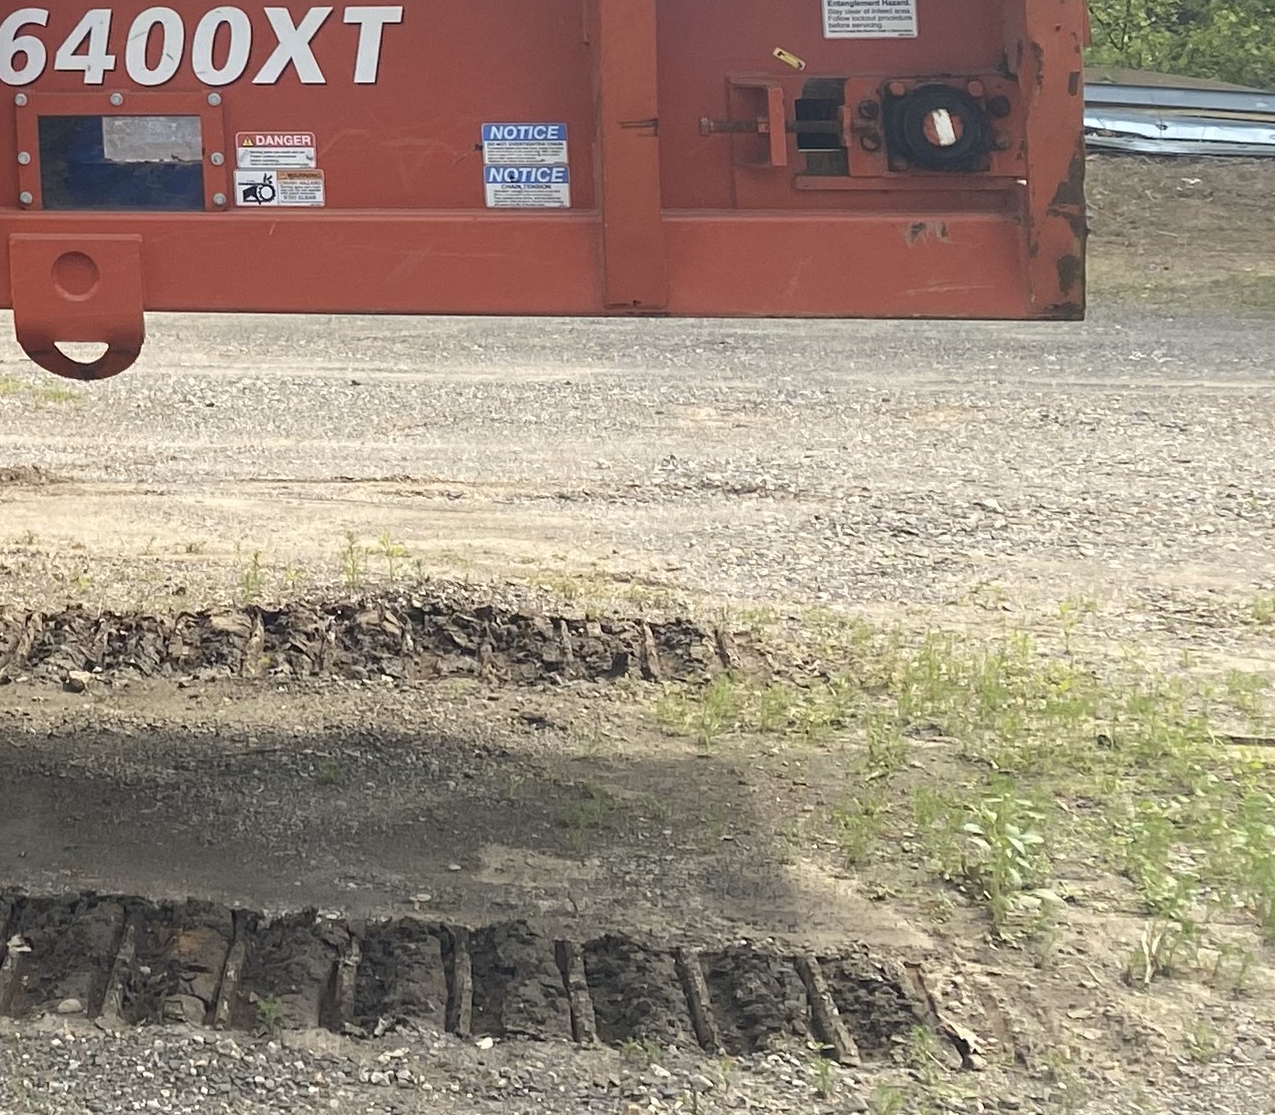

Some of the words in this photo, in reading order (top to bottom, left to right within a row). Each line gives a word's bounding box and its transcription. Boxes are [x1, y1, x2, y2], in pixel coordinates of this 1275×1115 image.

[490, 125, 559, 140] NOTICE
[255, 135, 311, 146] DANGER
[489, 167, 565, 182] NOTICE
